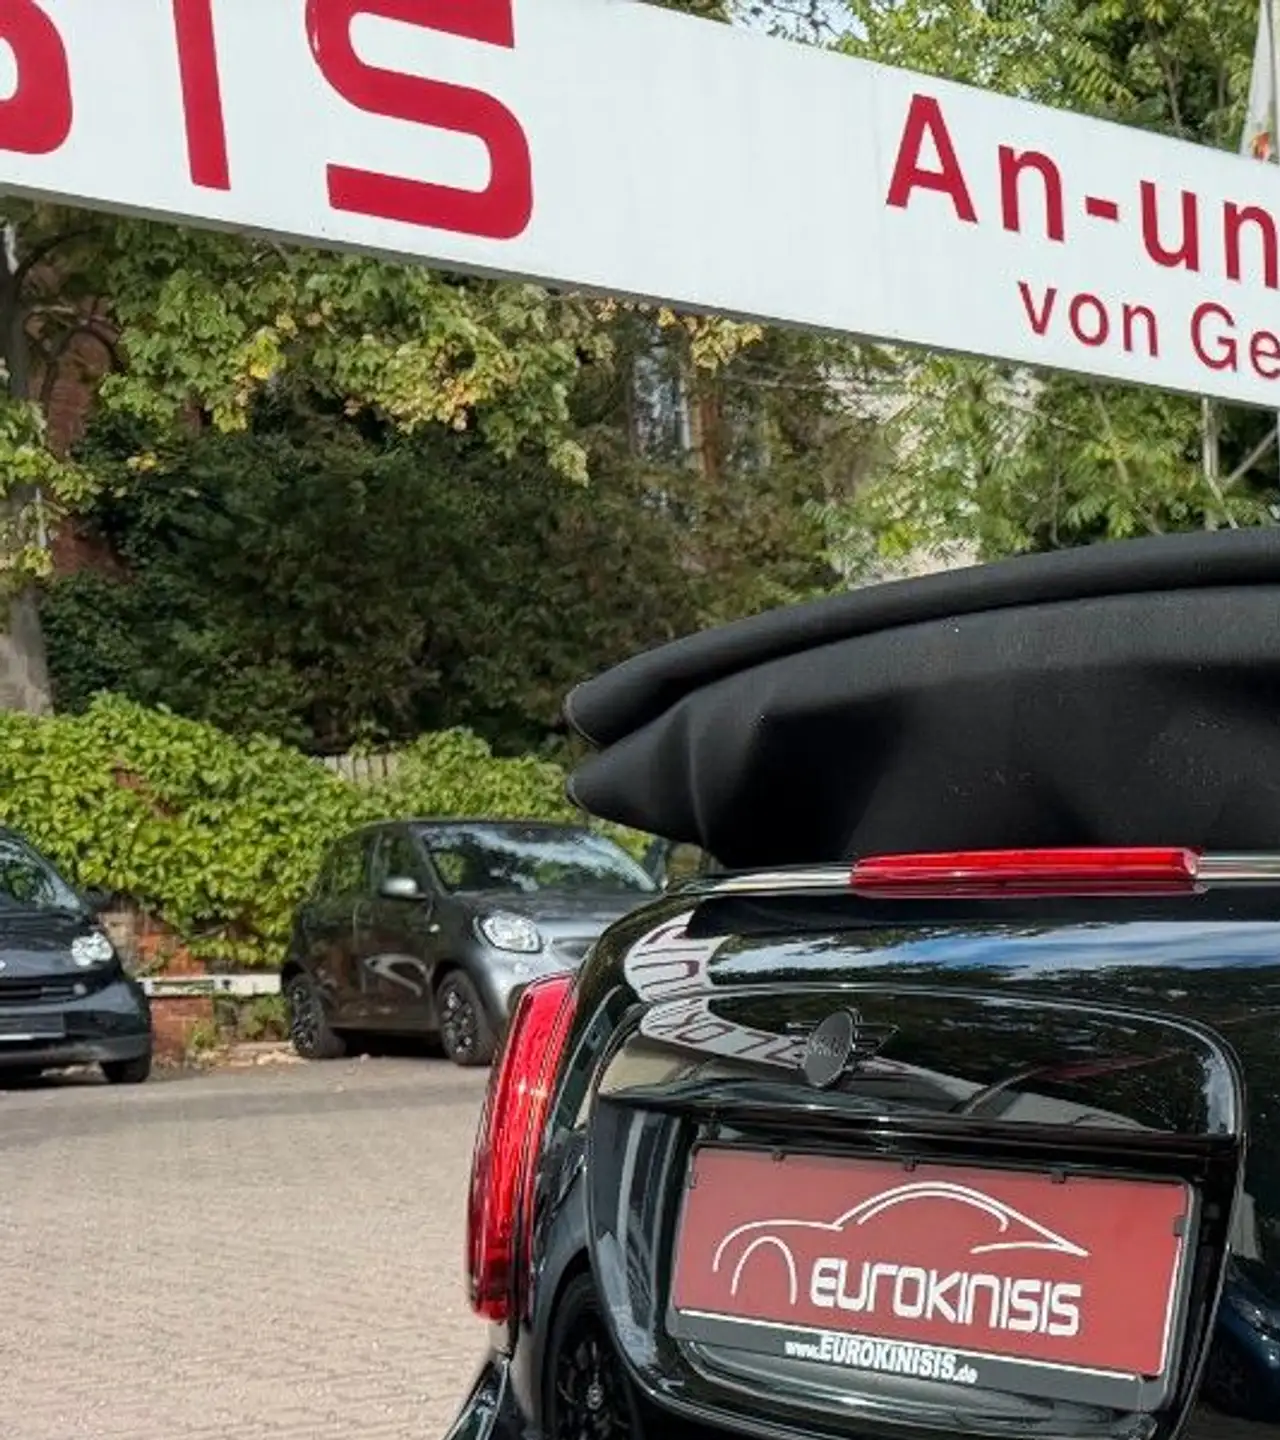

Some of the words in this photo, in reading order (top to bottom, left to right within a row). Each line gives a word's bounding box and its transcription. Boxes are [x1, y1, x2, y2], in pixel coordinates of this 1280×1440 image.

[0, 0, 534, 240] IS
[1018, 281, 1159, 357] von
[809, 1258, 1082, 1337] EUROKINISIS
[785, 1334, 977, 1384] www.EUROKINISIS.de
